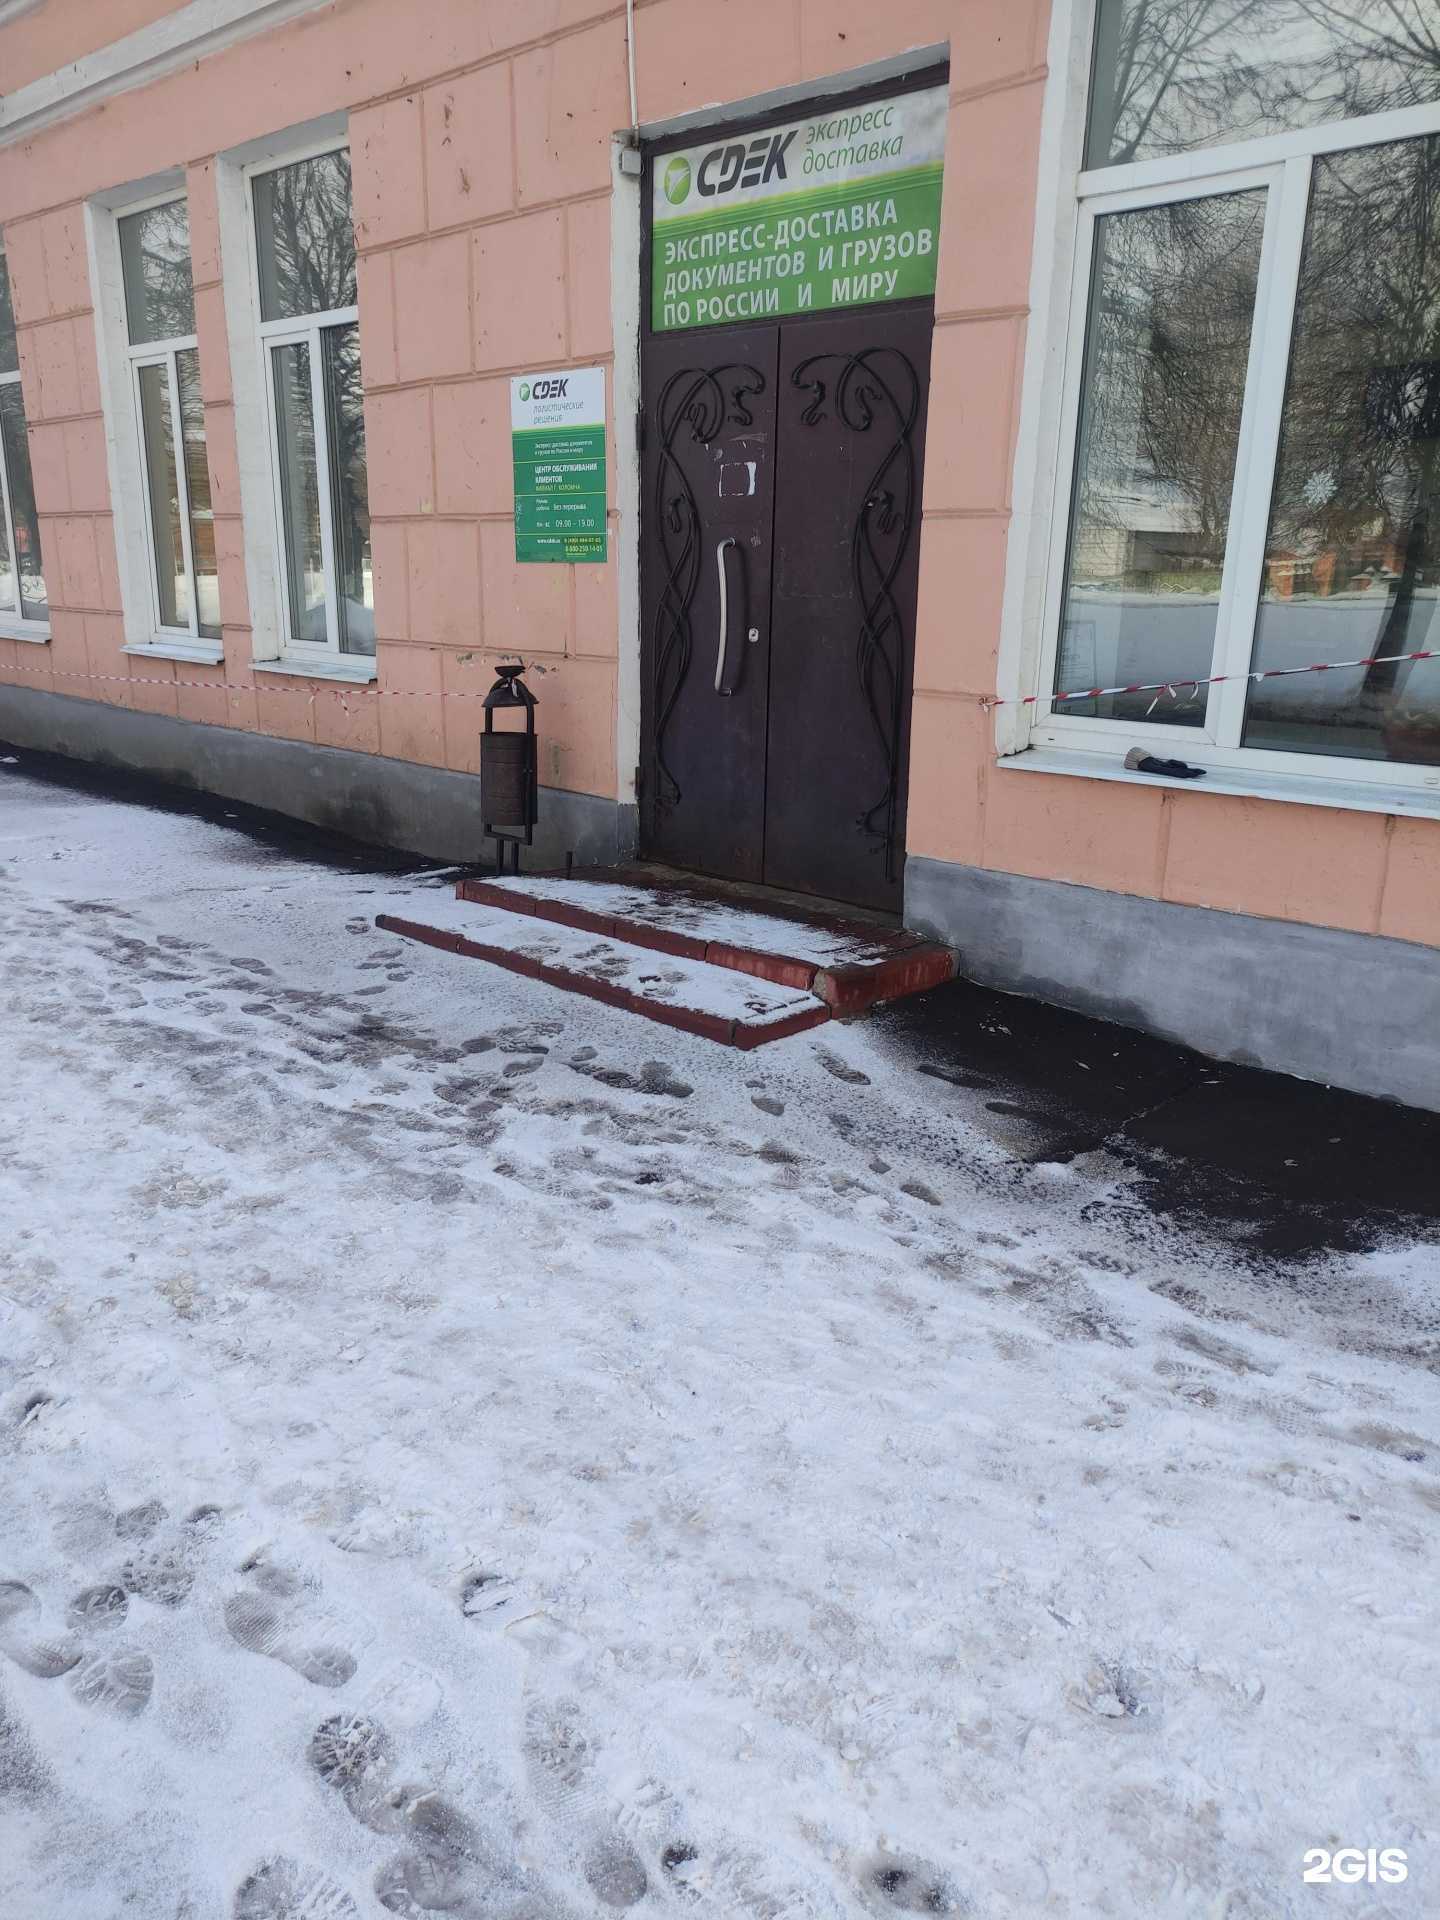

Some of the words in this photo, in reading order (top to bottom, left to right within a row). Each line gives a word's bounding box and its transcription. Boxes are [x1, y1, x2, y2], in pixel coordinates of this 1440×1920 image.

[806, 106, 894, 144] экспресс
[697, 130, 798, 197] CDEK
[802, 136, 903, 174] доставка
[665, 199, 898, 265] ЭКСПРЕСС-ДОСТАВКА
[664, 251, 805, 300] ДОКУМЕНТОВ
[818, 245, 833, 271] И
[842, 228, 932, 269] ГРУЗОВ
[664, 301, 690, 326] ПО
[697, 287, 779, 321] РОССИИ
[799, 282, 812, 308] И
[832, 269, 898, 304] МИРУ
[532, 378, 569, 400] CDEK
[535, 465, 551, 474] ЦЕНТР
[552, 463, 597, 473] ОБСЛУЖИВАНИЯ
[535, 475, 563, 484] КЛИЕНТОВ
